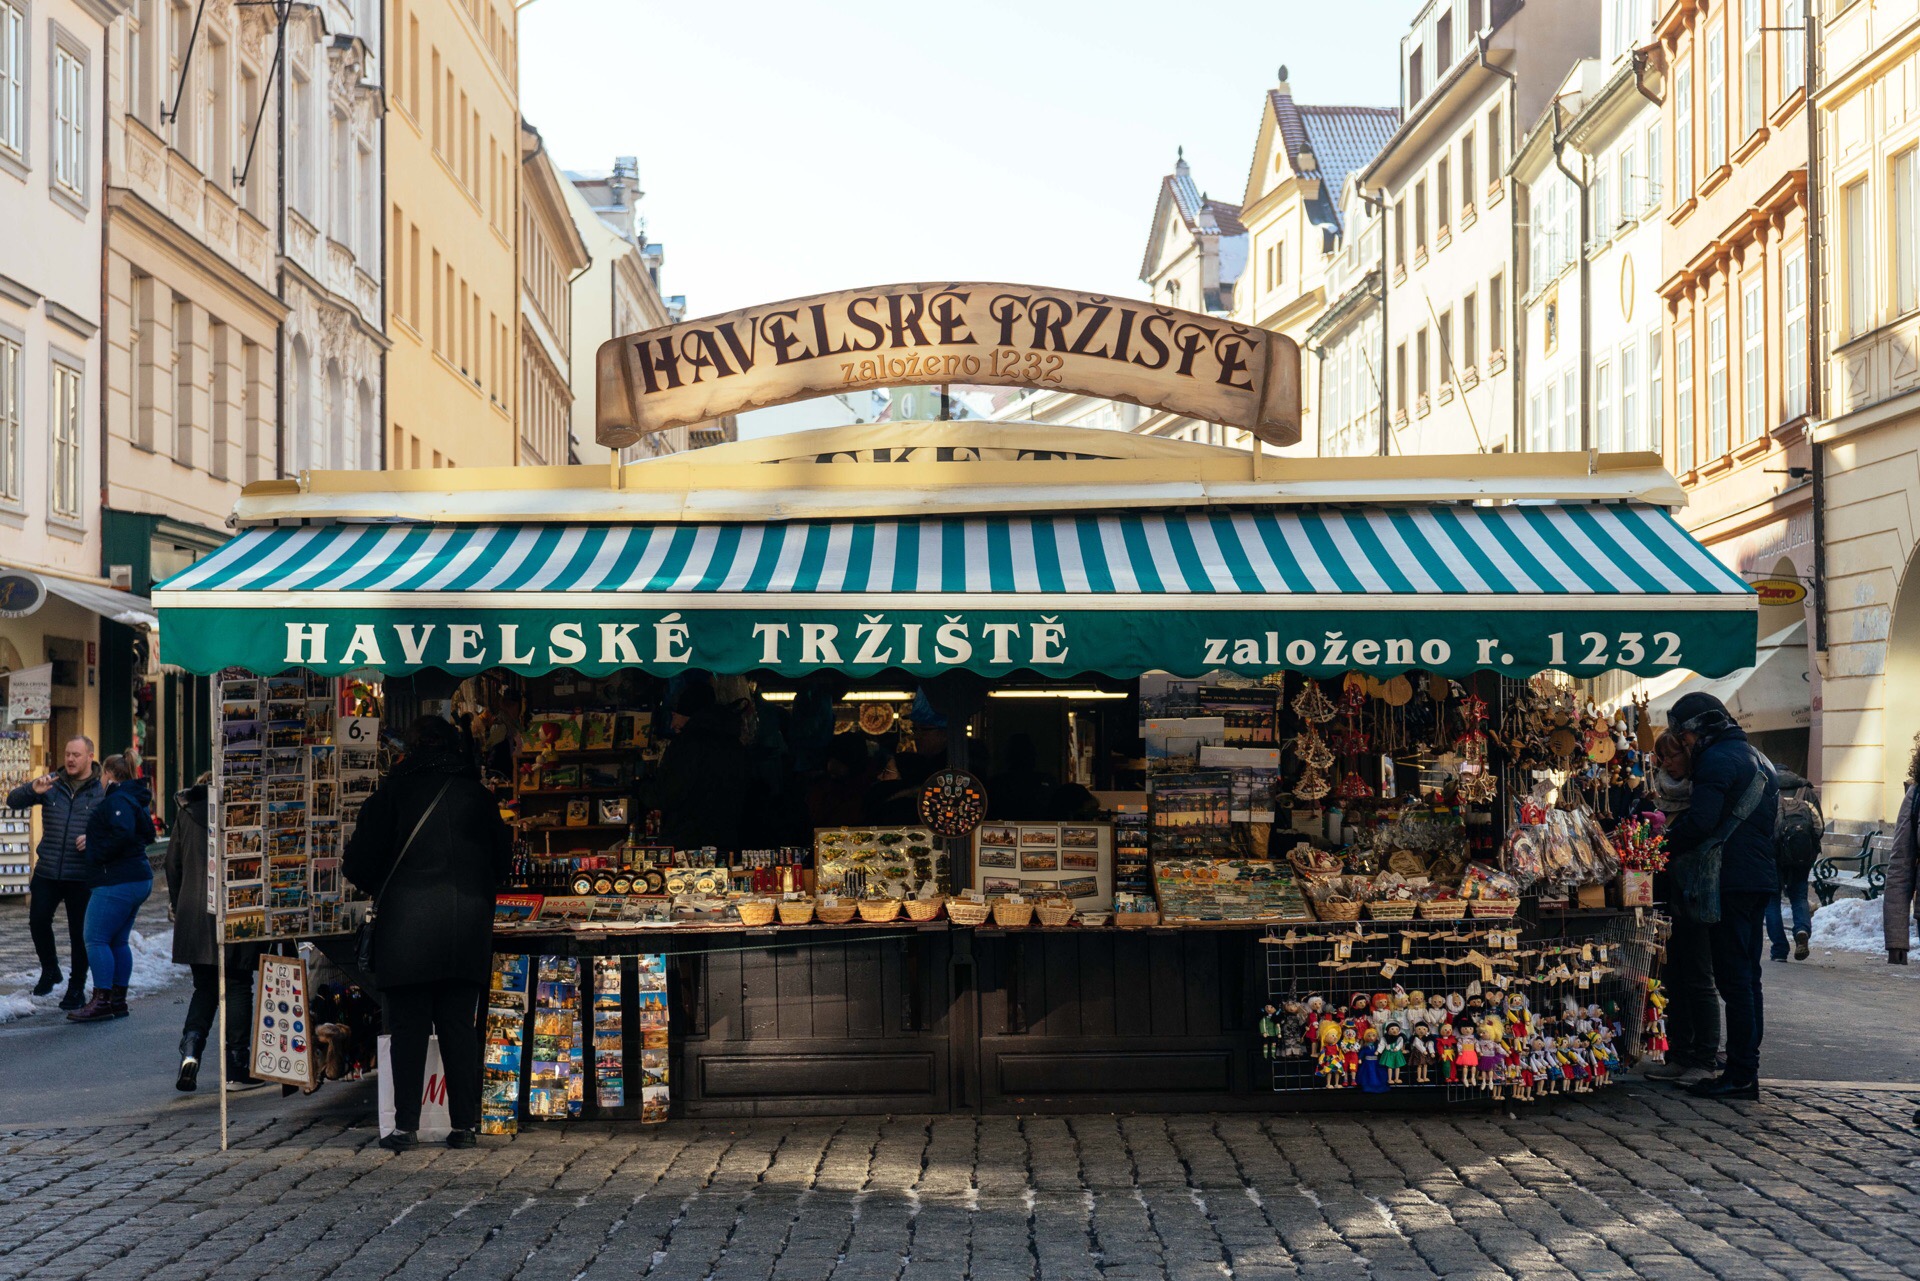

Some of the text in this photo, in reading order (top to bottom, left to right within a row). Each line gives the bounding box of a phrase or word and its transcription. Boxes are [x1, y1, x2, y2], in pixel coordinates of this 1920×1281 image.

[634, 283, 1261, 394] HAVELSKÉ TRŽIŠTĚ
[841, 348, 1065, 384] založeno 1232
[283, 612, 1683, 666] HAVELSKÉ TRŽIŠTĚ založeno r. 1232
[348, 719, 371, 743] 6,-
[545, 900, 588, 908] PRAGA
[260, 1055, 273, 1070] CZ
[279, 1059, 289, 1070] CZ
